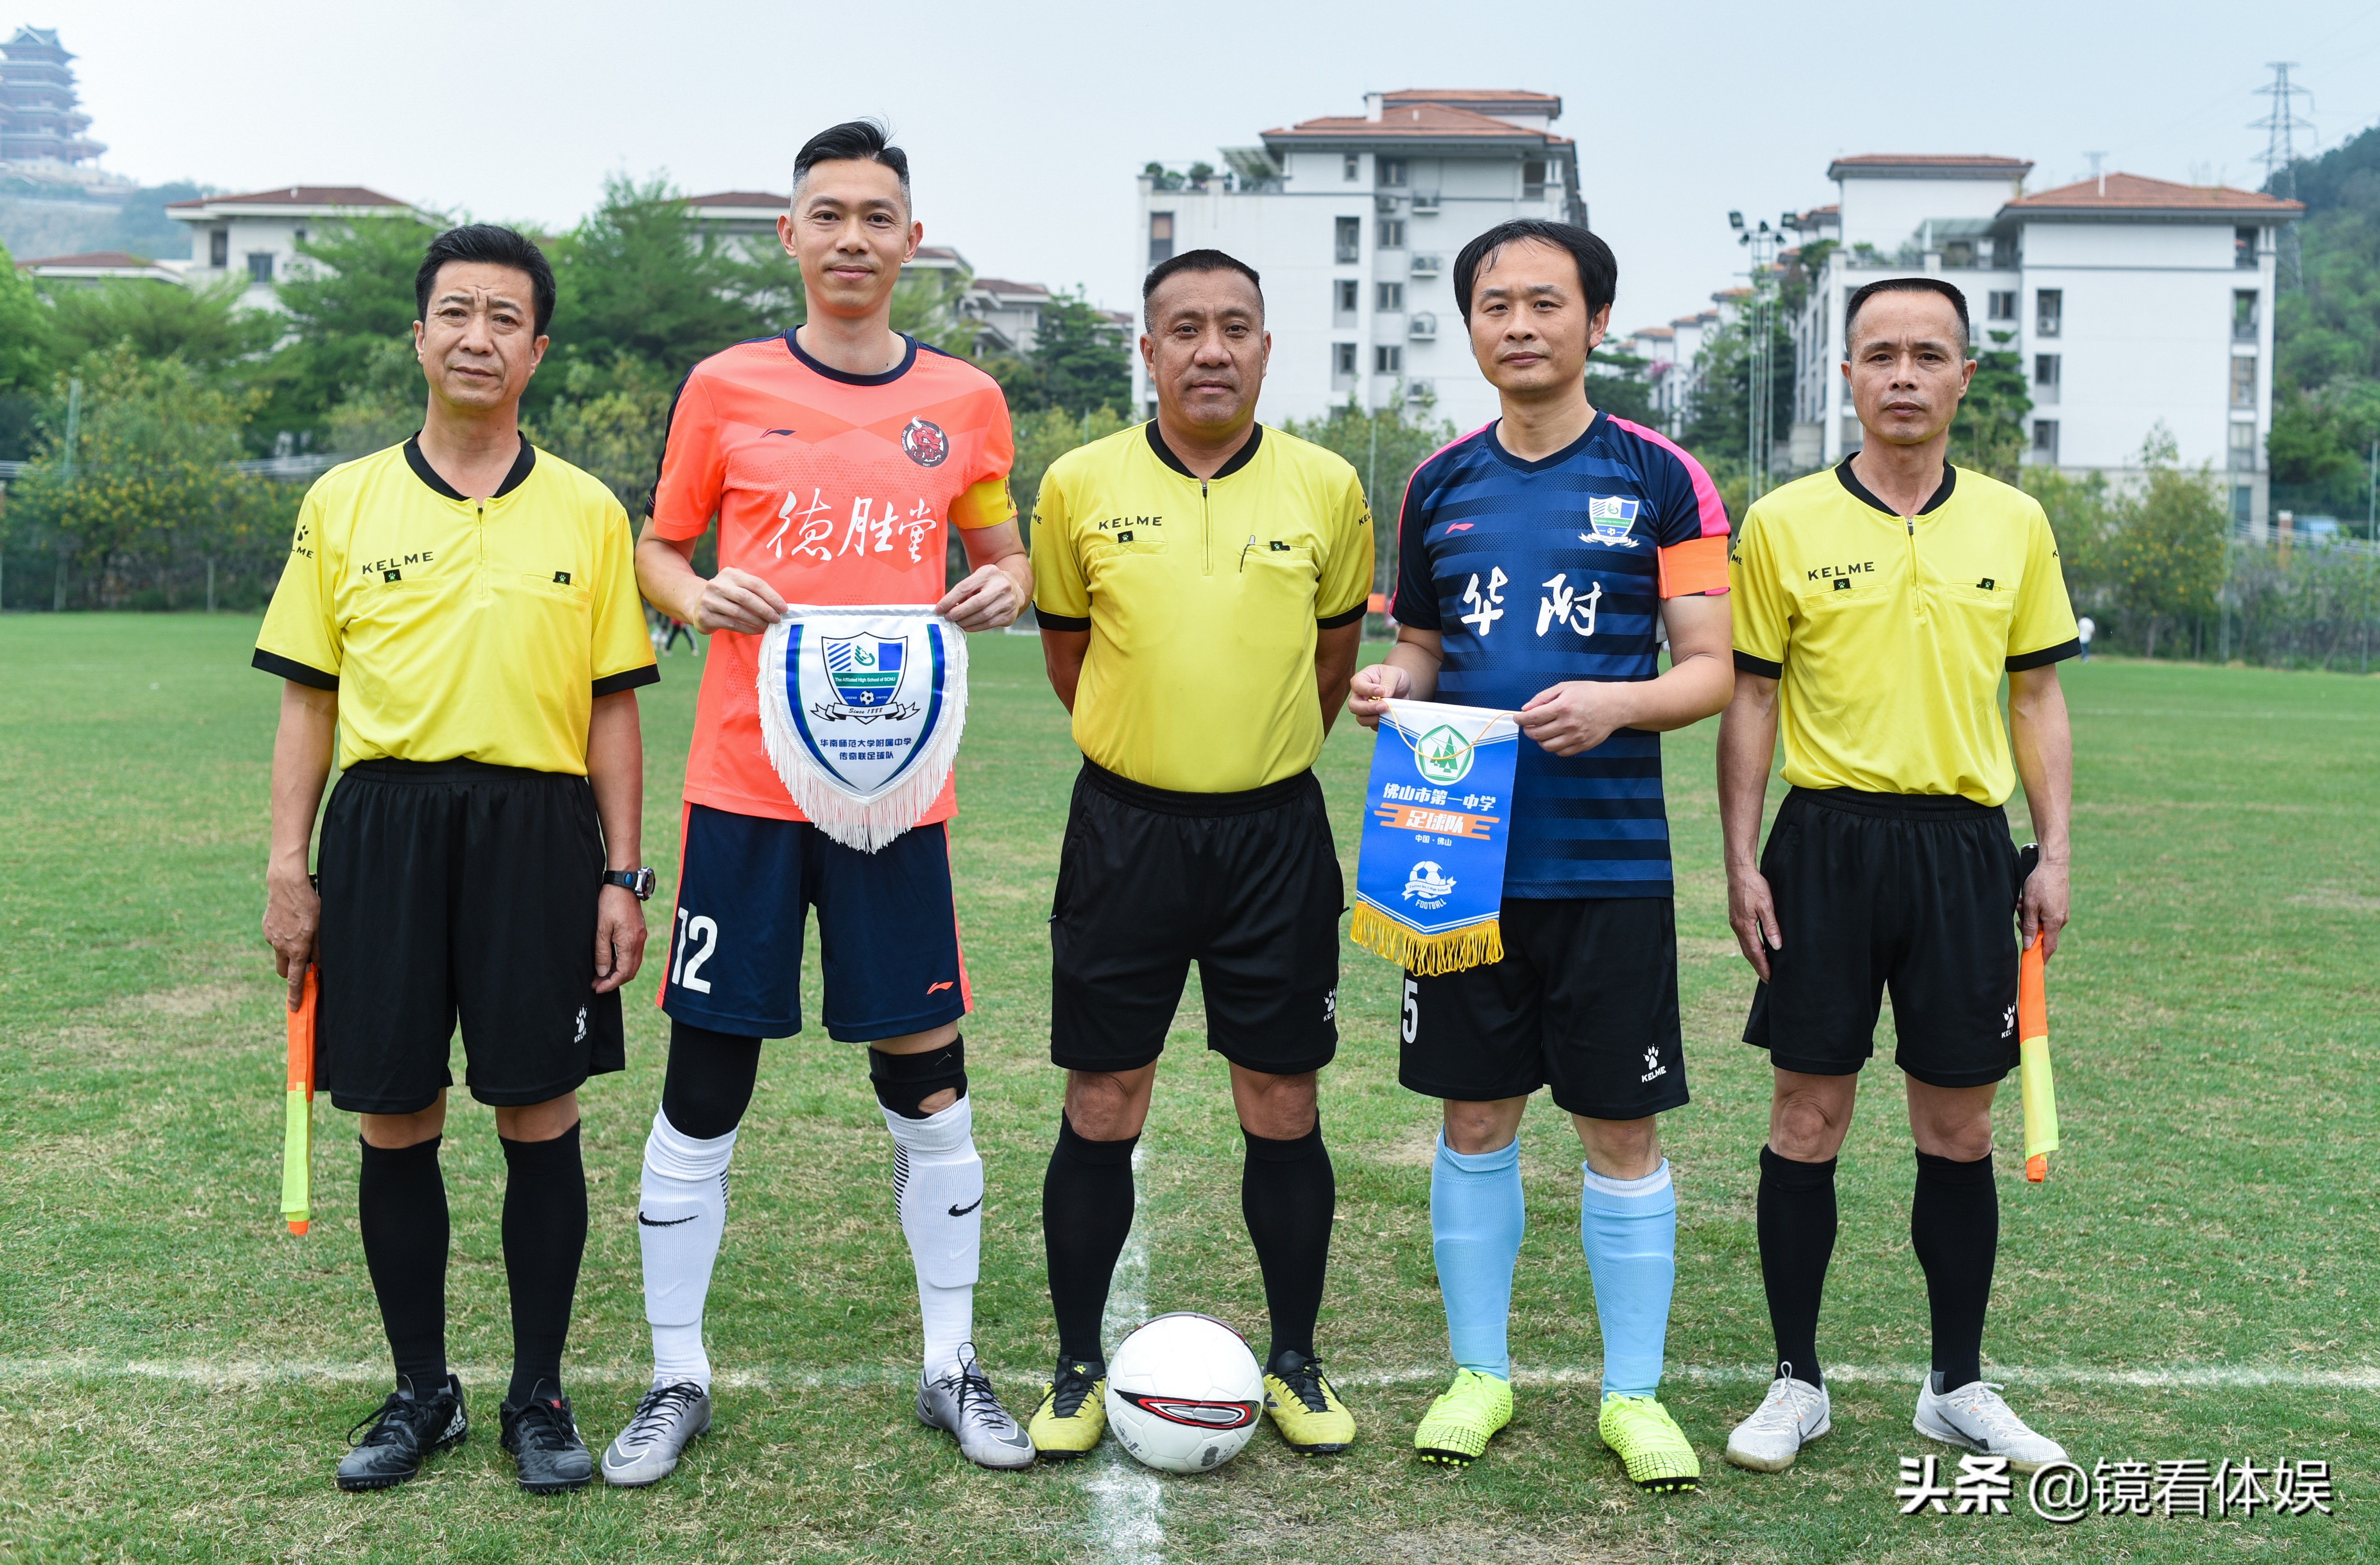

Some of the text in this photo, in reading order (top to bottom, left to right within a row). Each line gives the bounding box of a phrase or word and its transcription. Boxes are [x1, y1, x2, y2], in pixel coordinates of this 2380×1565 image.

[766, 487, 937, 564] 德胜堂
[1098, 515, 1162, 530] KELME
[362, 551, 434, 574] KELME
[1808, 561, 1875, 581] KELME
[1460, 566, 1602, 637] 华附
[820, 737, 912, 747] 华南师范大学附属中学
[839, 751, 894, 760] 传奇联足球队
[1383, 782, 1496, 812] 佛山市第一中学
[1405, 810, 1464, 834] 足球队
[1415, 898, 1447, 910] FOOTBALL
[672, 907, 718, 995] 12
[1402, 978, 1418, 1043] 5
[1642, 1066, 1666, 1083] KELME
